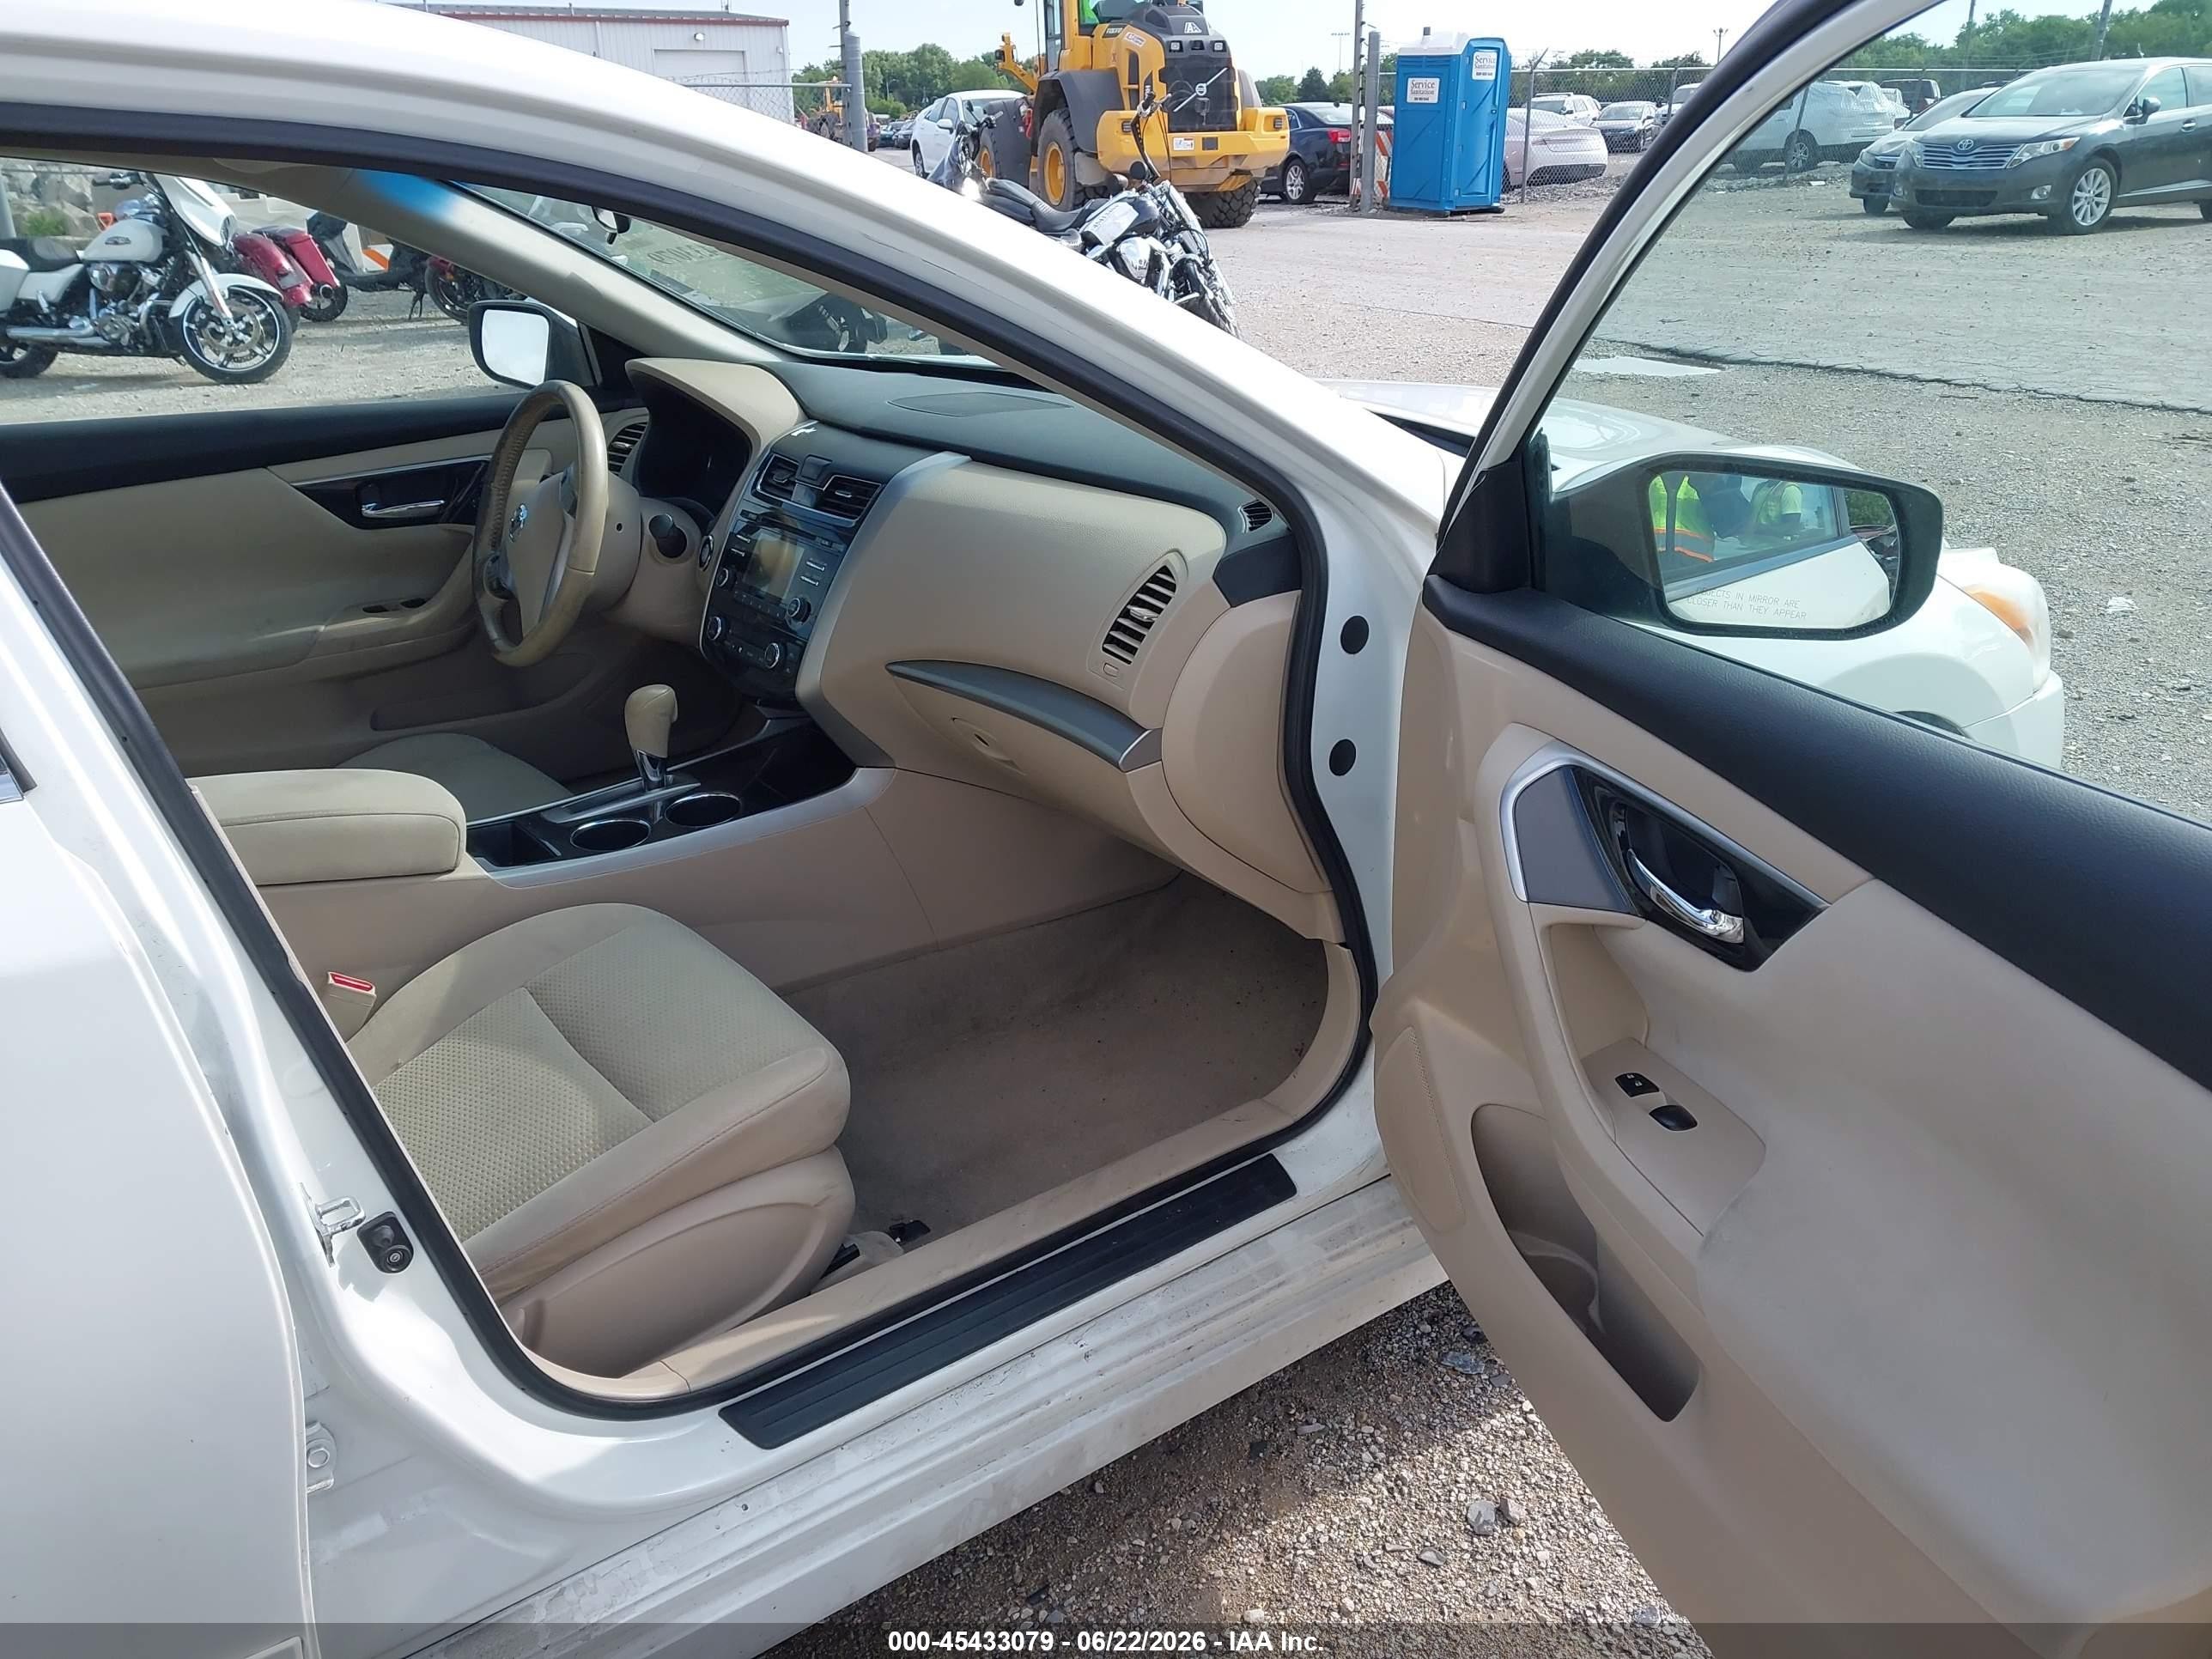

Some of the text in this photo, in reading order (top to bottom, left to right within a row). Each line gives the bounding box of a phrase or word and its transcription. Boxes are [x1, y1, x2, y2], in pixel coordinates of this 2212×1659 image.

[1474, 54, 1496, 64] Service
[1411, 79, 1436, 89] Service
[1696, 586, 1801, 609] OBJECTS IN MIRROR ARE
[1686, 597, 1807, 620] CLOSER THAN THEY APPEAR
